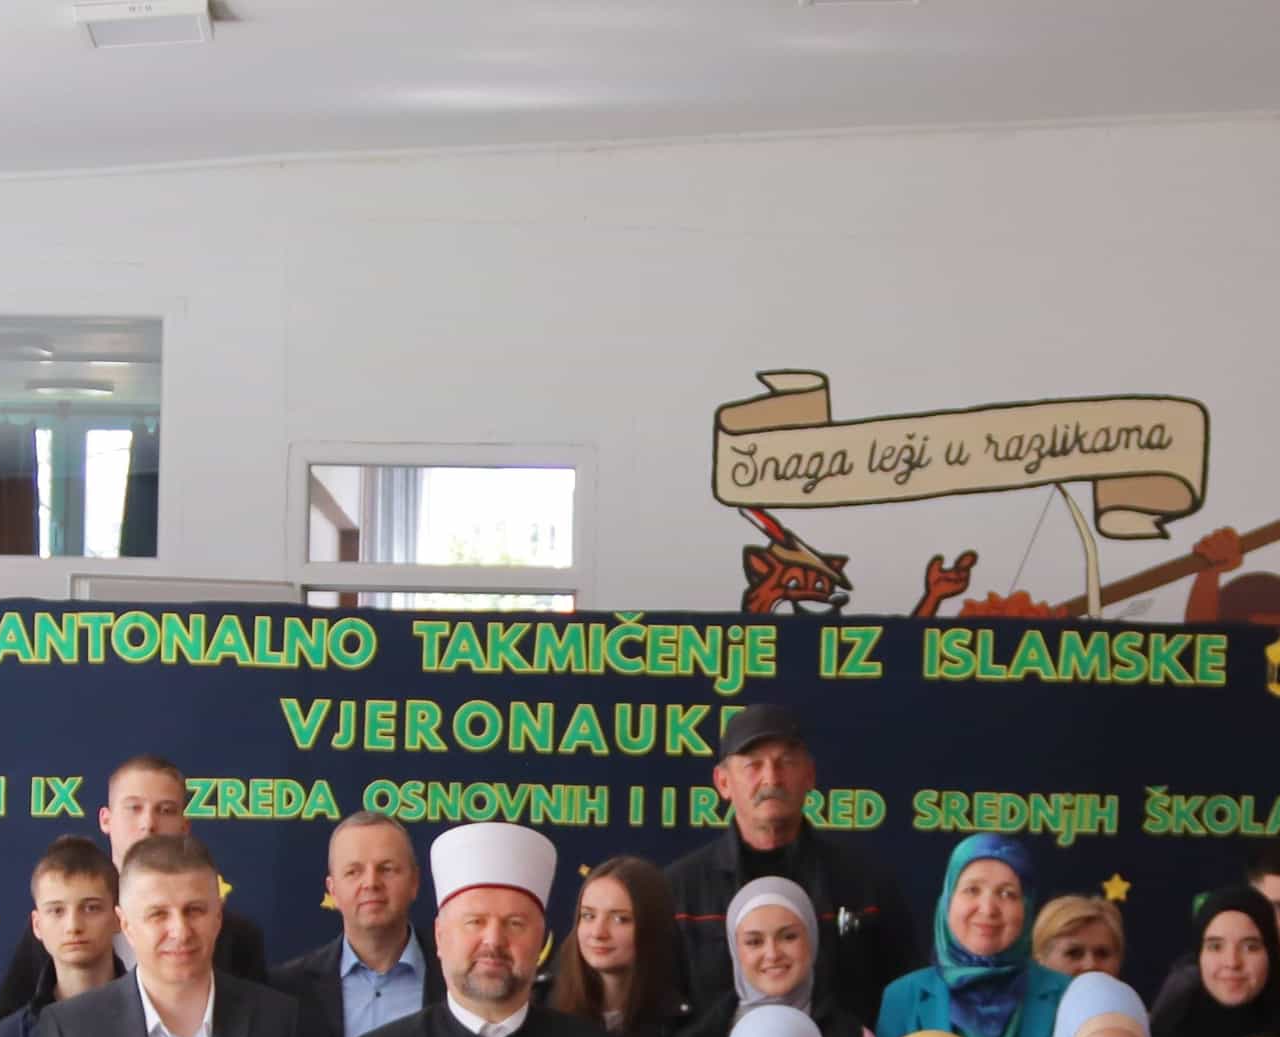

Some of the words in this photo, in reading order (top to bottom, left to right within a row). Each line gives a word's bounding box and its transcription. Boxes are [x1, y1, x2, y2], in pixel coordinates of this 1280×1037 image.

[730, 442, 854, 494] Snaga
[867, 432, 932, 486] leži
[945, 439, 970, 466] u
[984, 420, 1173, 475] razlikama
[820, 625, 884, 678] IZ
[923, 627, 1228, 685] ISLAMSKE
[31, 777, 88, 818] IX
[182, 777, 341, 820] ZREDA
[363, 780, 609, 826] OSNOVNIH
[628, 785, 644, 826] I
[661, 786, 677, 827] I
